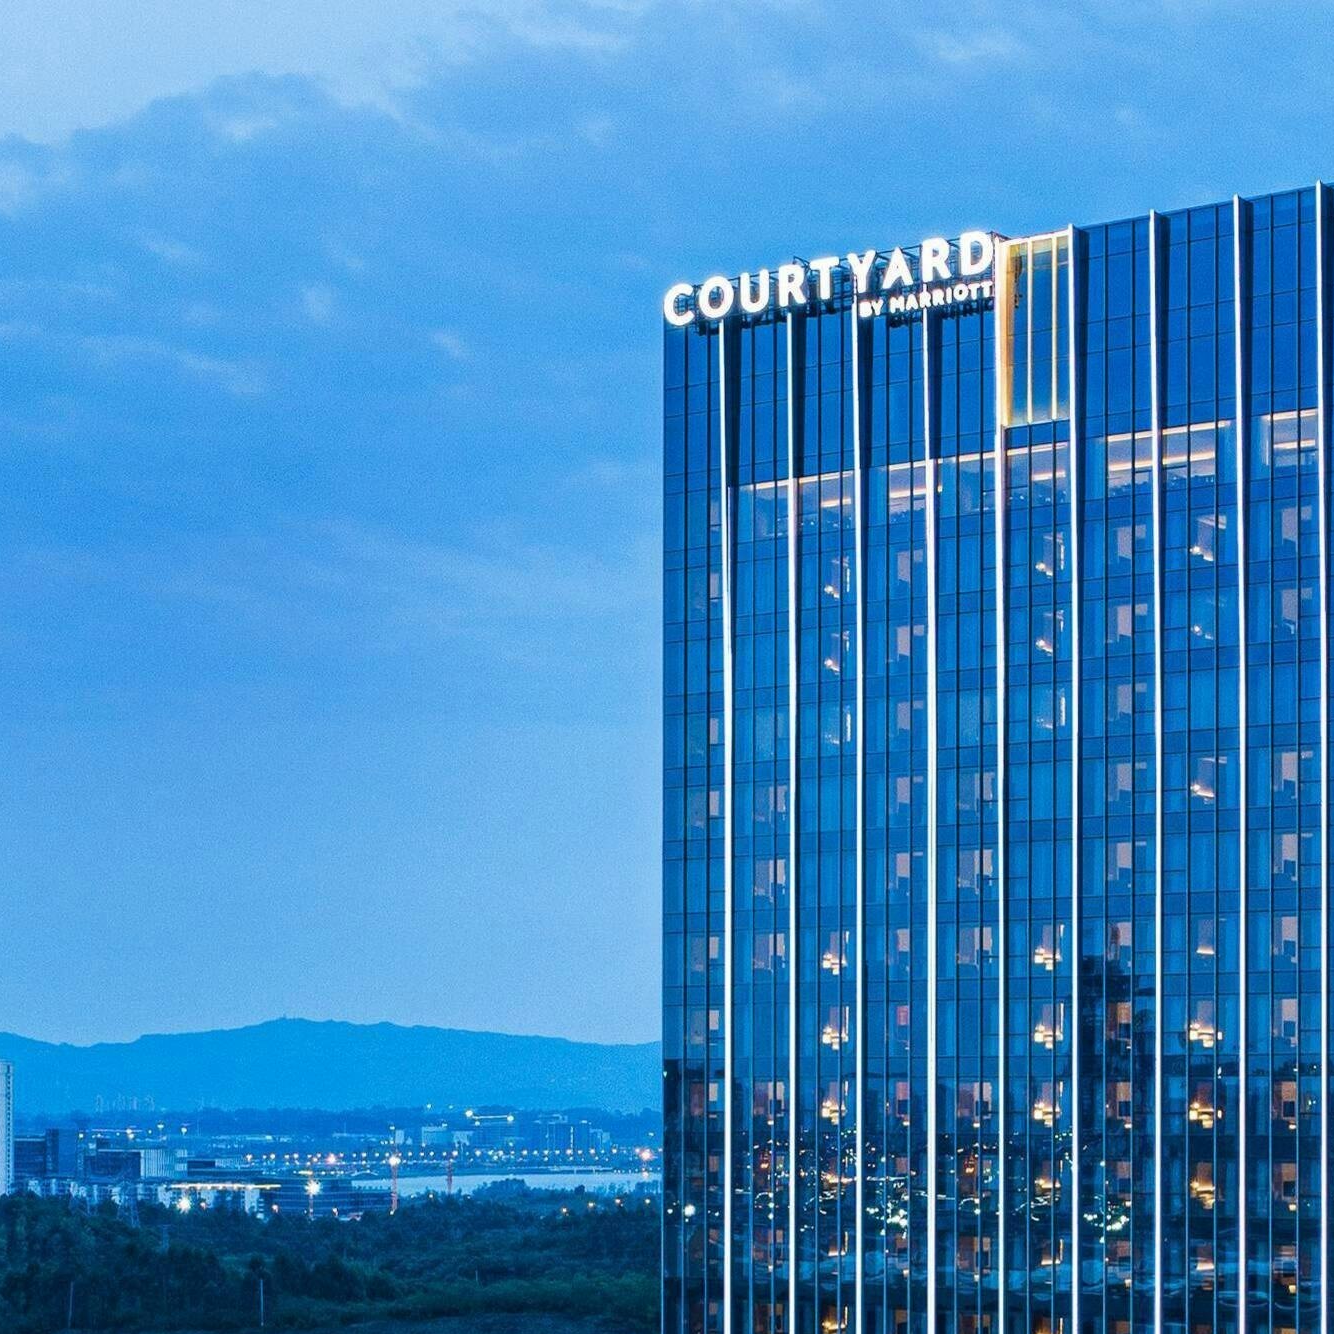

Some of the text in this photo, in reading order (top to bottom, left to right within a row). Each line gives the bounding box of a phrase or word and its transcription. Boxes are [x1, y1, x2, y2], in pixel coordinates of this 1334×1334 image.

[663, 231, 994, 326] COURTYARD
[859, 280, 993, 318] BY MARRIOTT
